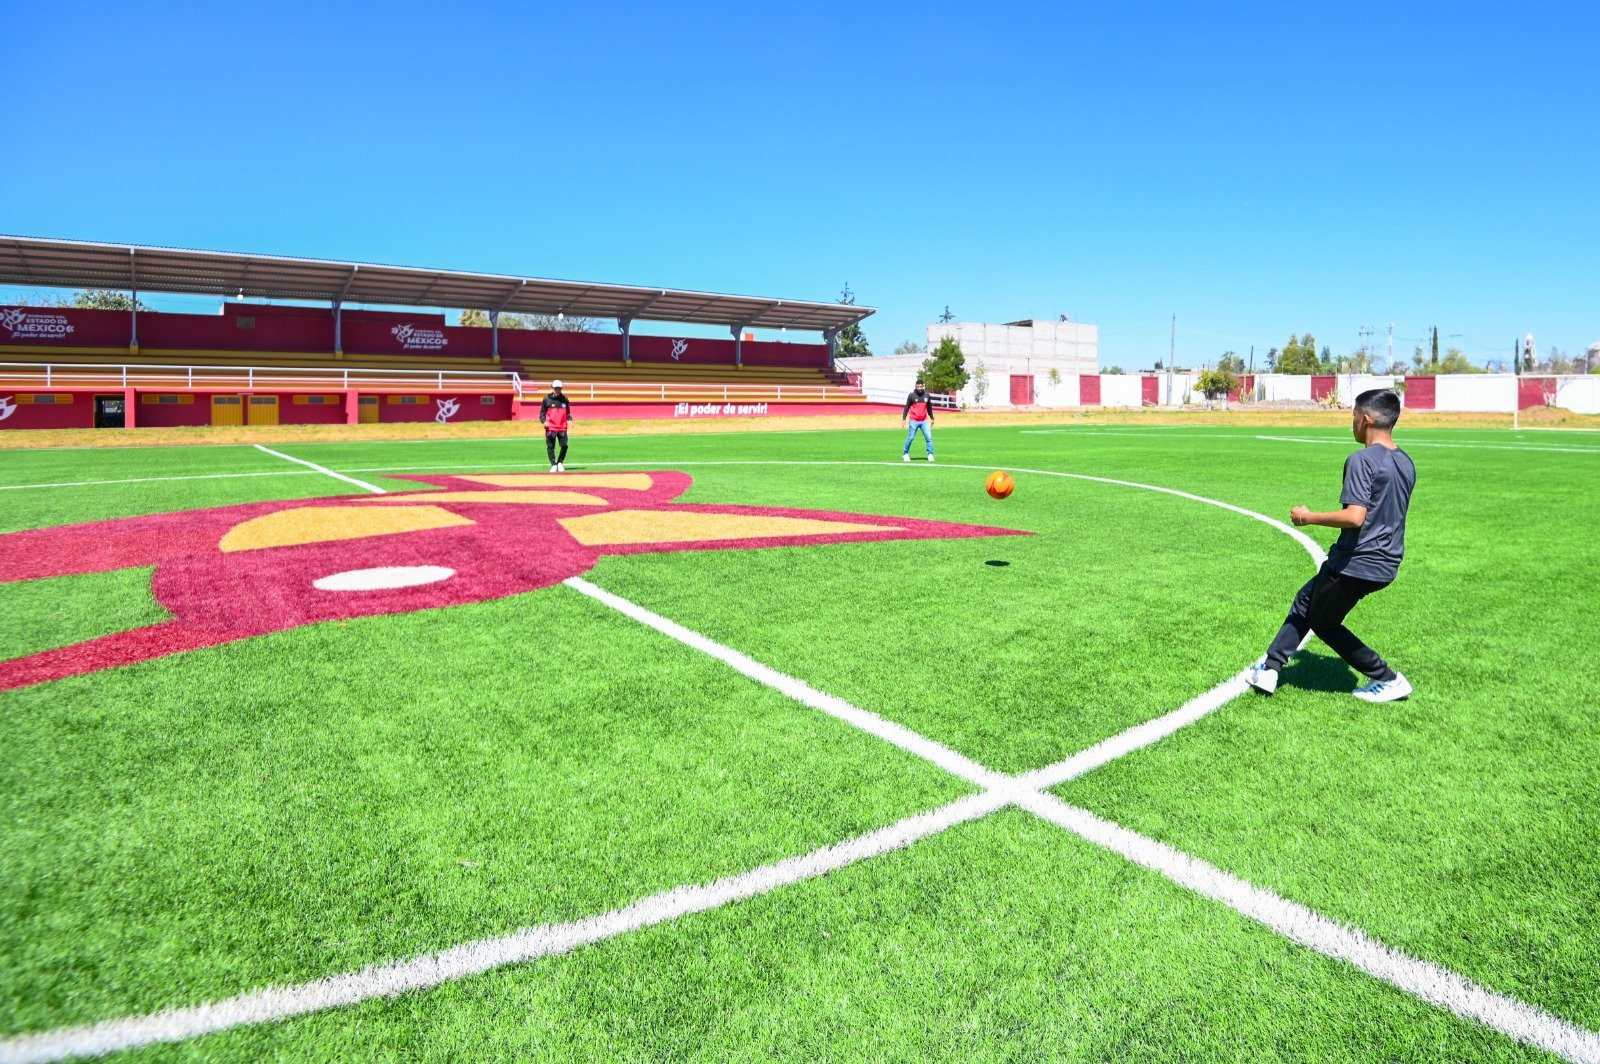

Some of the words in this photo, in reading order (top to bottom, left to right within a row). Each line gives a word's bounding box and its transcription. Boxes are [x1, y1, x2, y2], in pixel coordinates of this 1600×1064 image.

[674, 402, 689, 417] ¡El
[690, 402, 721, 417] poder
[723, 402, 736, 415] de
[737, 402, 768, 415] servir!
